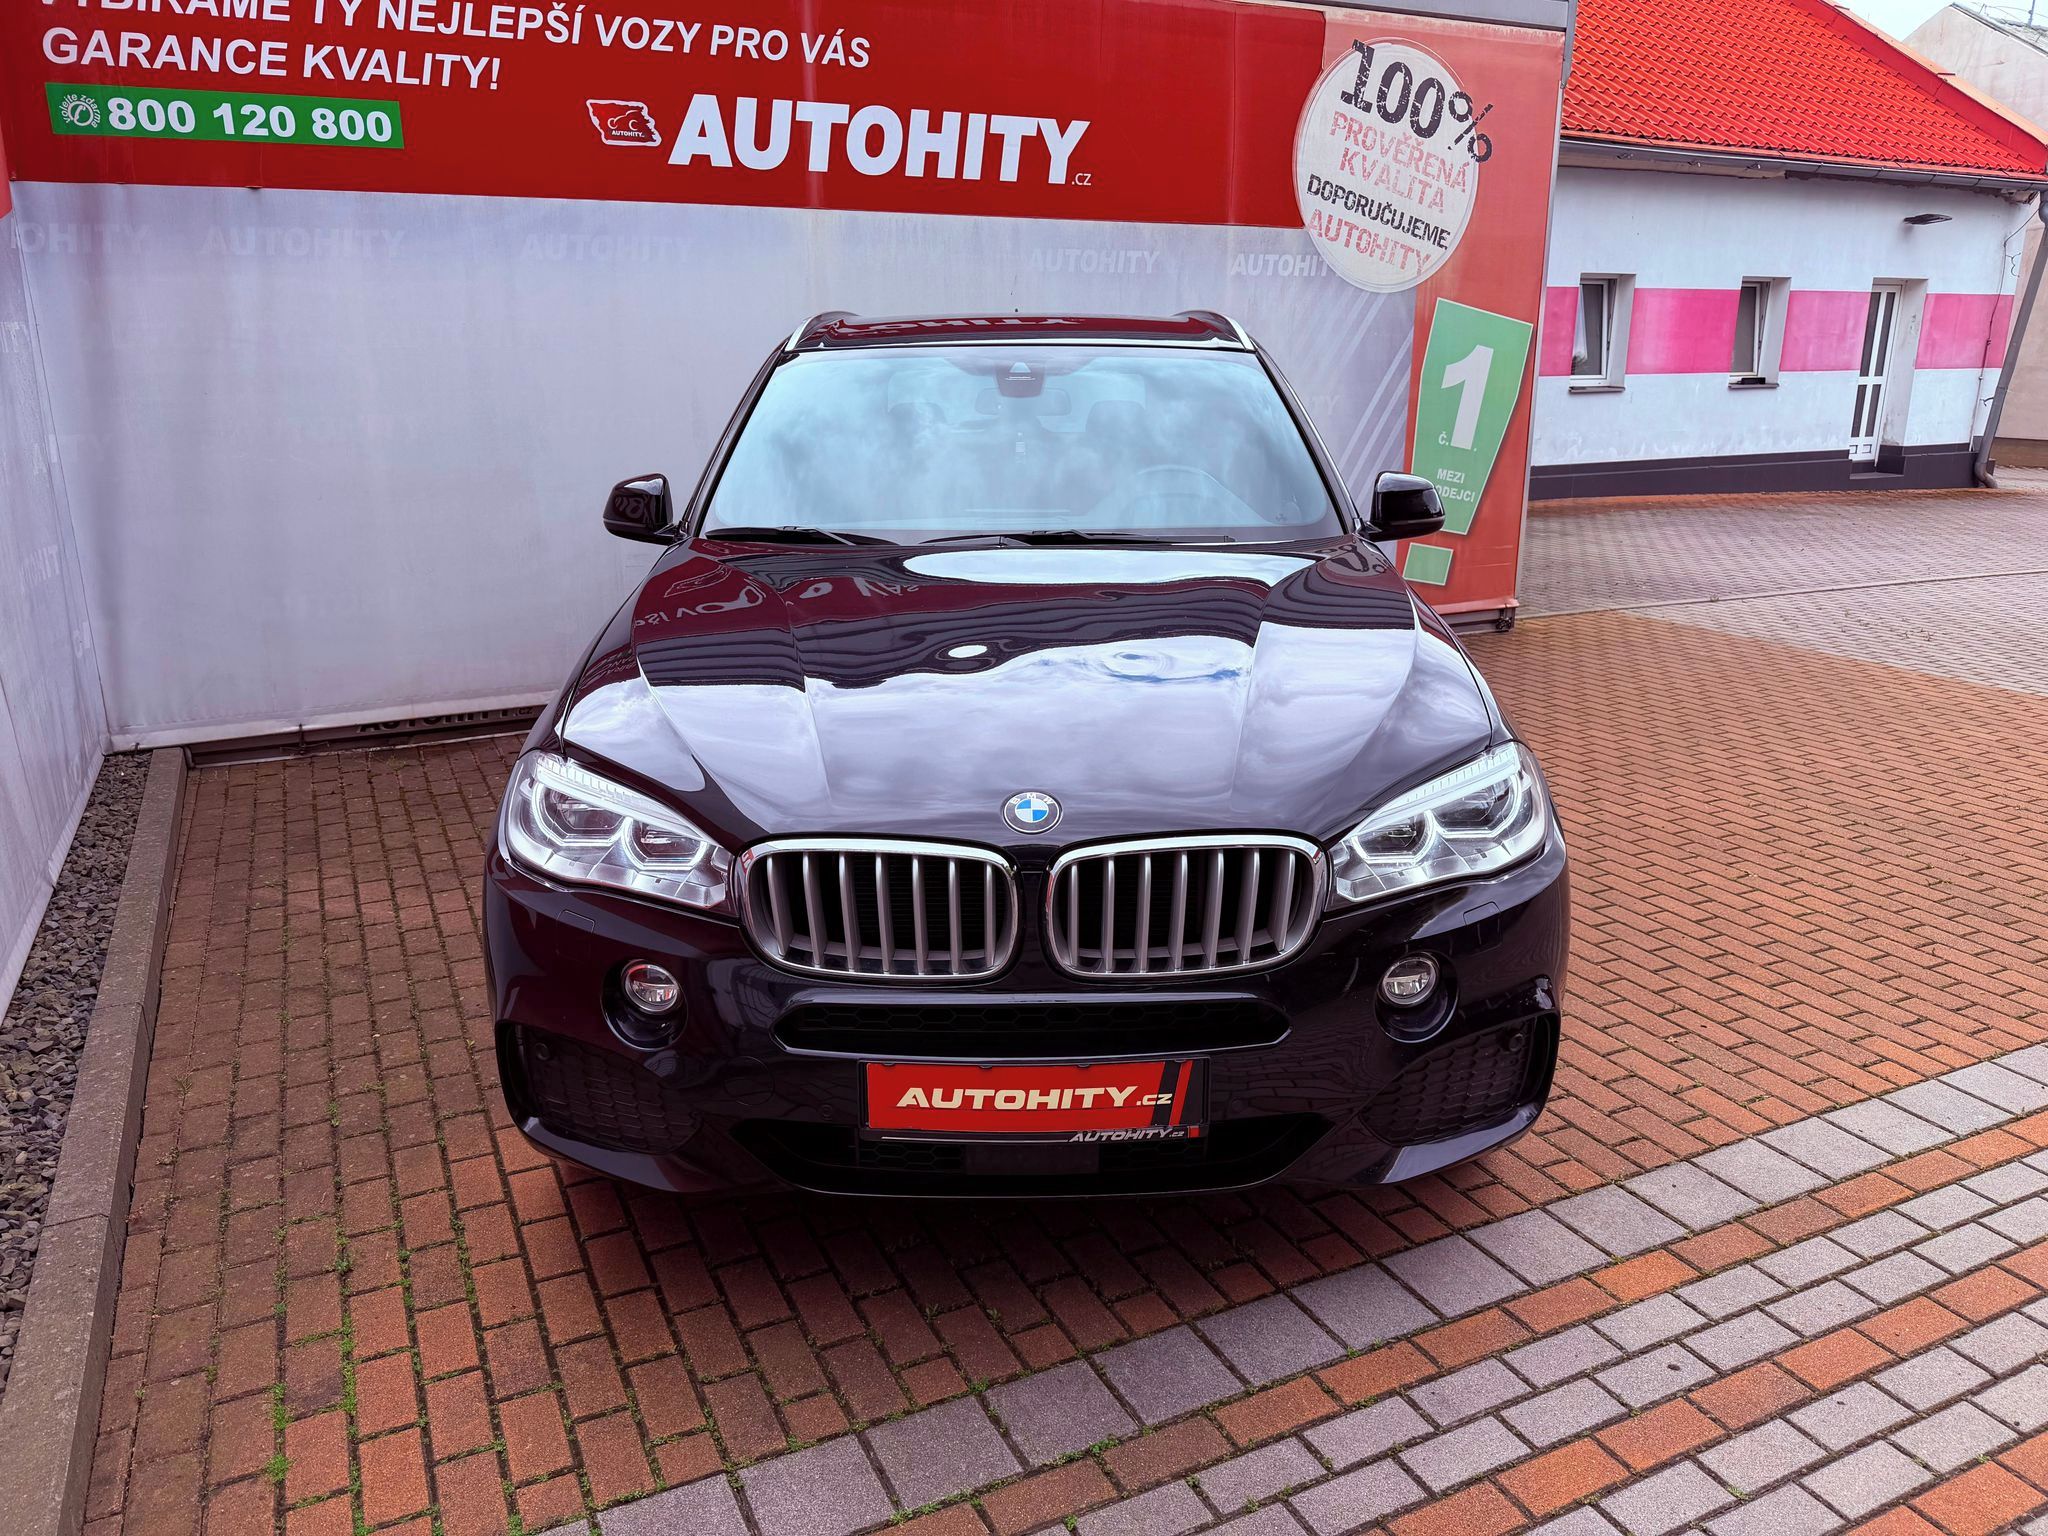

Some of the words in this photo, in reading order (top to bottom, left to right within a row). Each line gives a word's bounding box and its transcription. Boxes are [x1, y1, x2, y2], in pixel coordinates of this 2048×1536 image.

[42, 26, 288, 77] GARANCE
[303, 44, 501, 90] KVALITY!
[377, 0, 586, 45] NEJLEPŠÍ
[594, 14, 702, 54] VOZY
[709, 24, 789, 61] PRO
[800, 28, 871, 68] VÁS
[107, 97, 196, 133] 800
[213, 102, 296, 138] 120
[311, 107, 393, 142] 800
[1340, 39, 1494, 164] 100%
[1329, 110, 1470, 193] PROVĚŘENÁ
[1339, 147, 1444, 214] KVALITA
[1306, 173, 1451, 250] DOPORUČUJEME
[1308, 208, 1431, 277] AUTOHITY
[1028, 248, 1161, 275] AUTOHITY
[1230, 253, 1330, 278] AUTOHIT
[1437, 468, 1466, 484] MEZI
